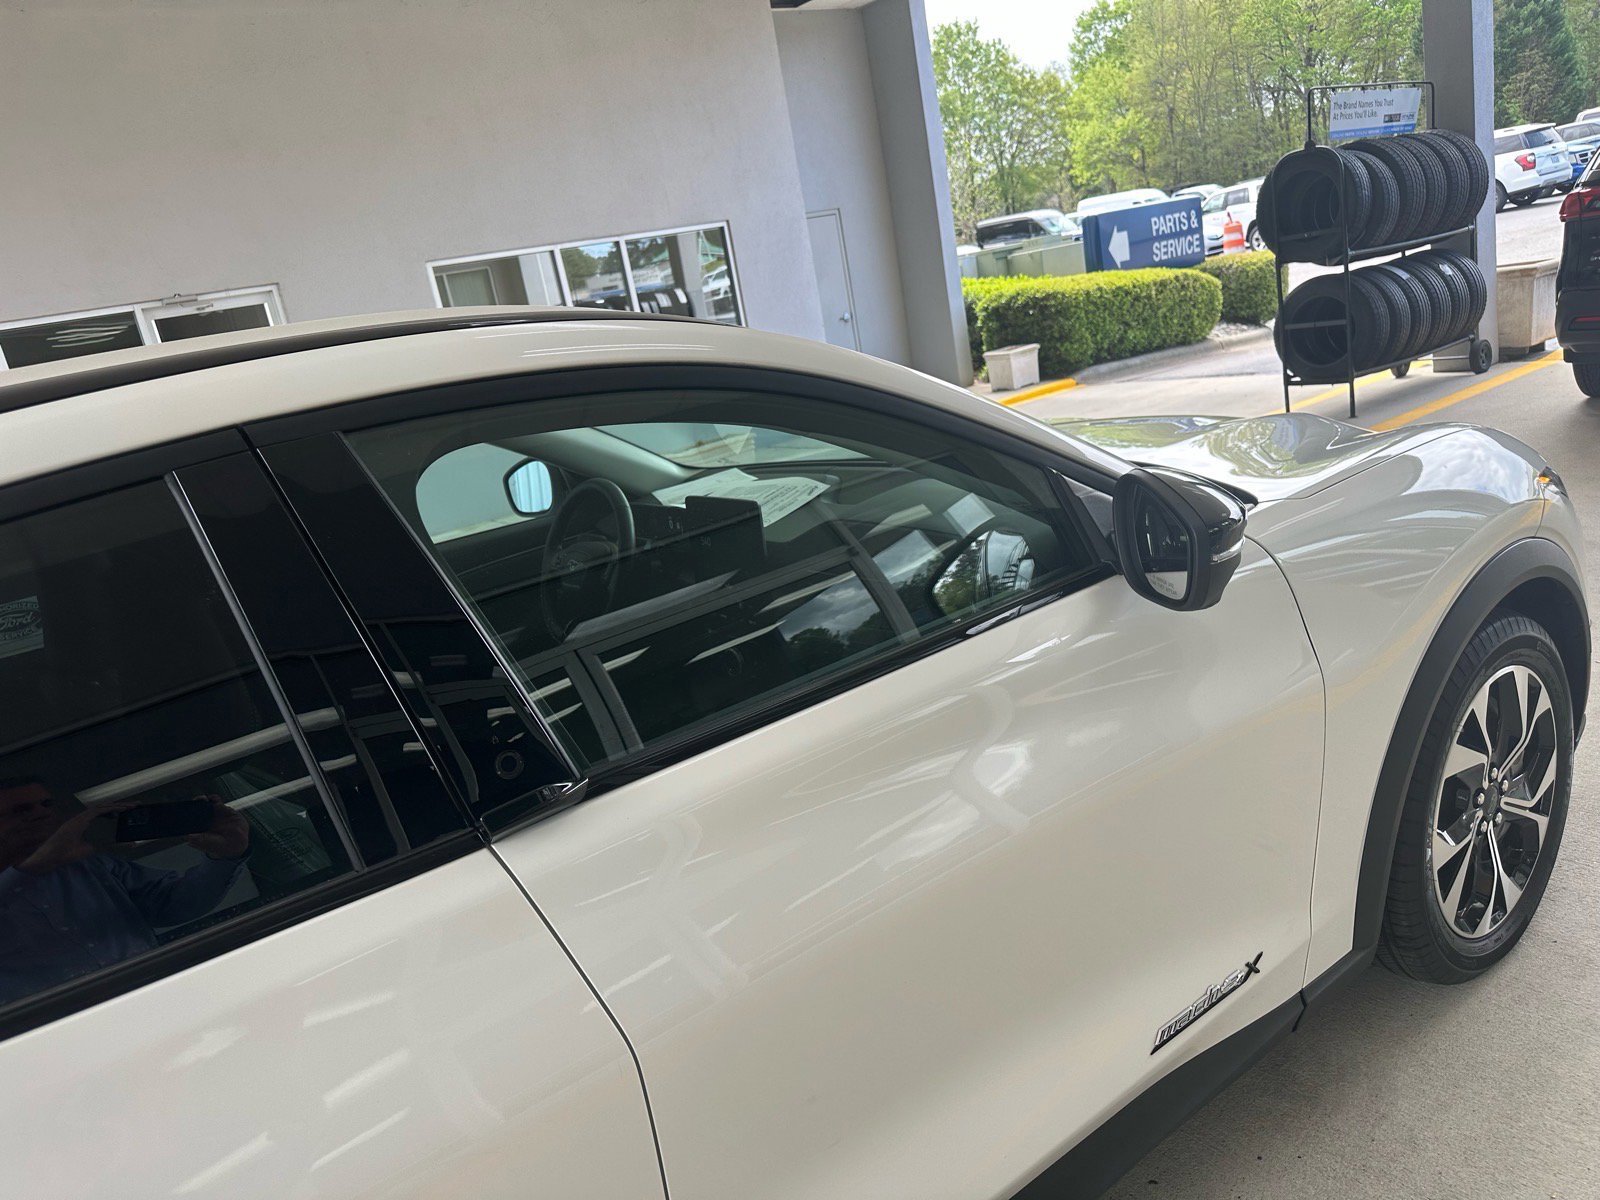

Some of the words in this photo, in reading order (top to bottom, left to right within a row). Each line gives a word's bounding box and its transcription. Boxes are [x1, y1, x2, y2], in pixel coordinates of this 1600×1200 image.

[1333, 102, 1342, 110] The
[1343, 100, 1357, 110] Brand
[1358, 100, 1374, 108] Names
[1374, 99, 1383, 107] You
[1383, 98, 1394, 106] Trust
[1339, 111, 1353, 120] Prices
[1151, 211, 1188, 236] PARTS
[1190, 209, 1198, 229] &
[1152, 234, 1201, 262] SERVICE
